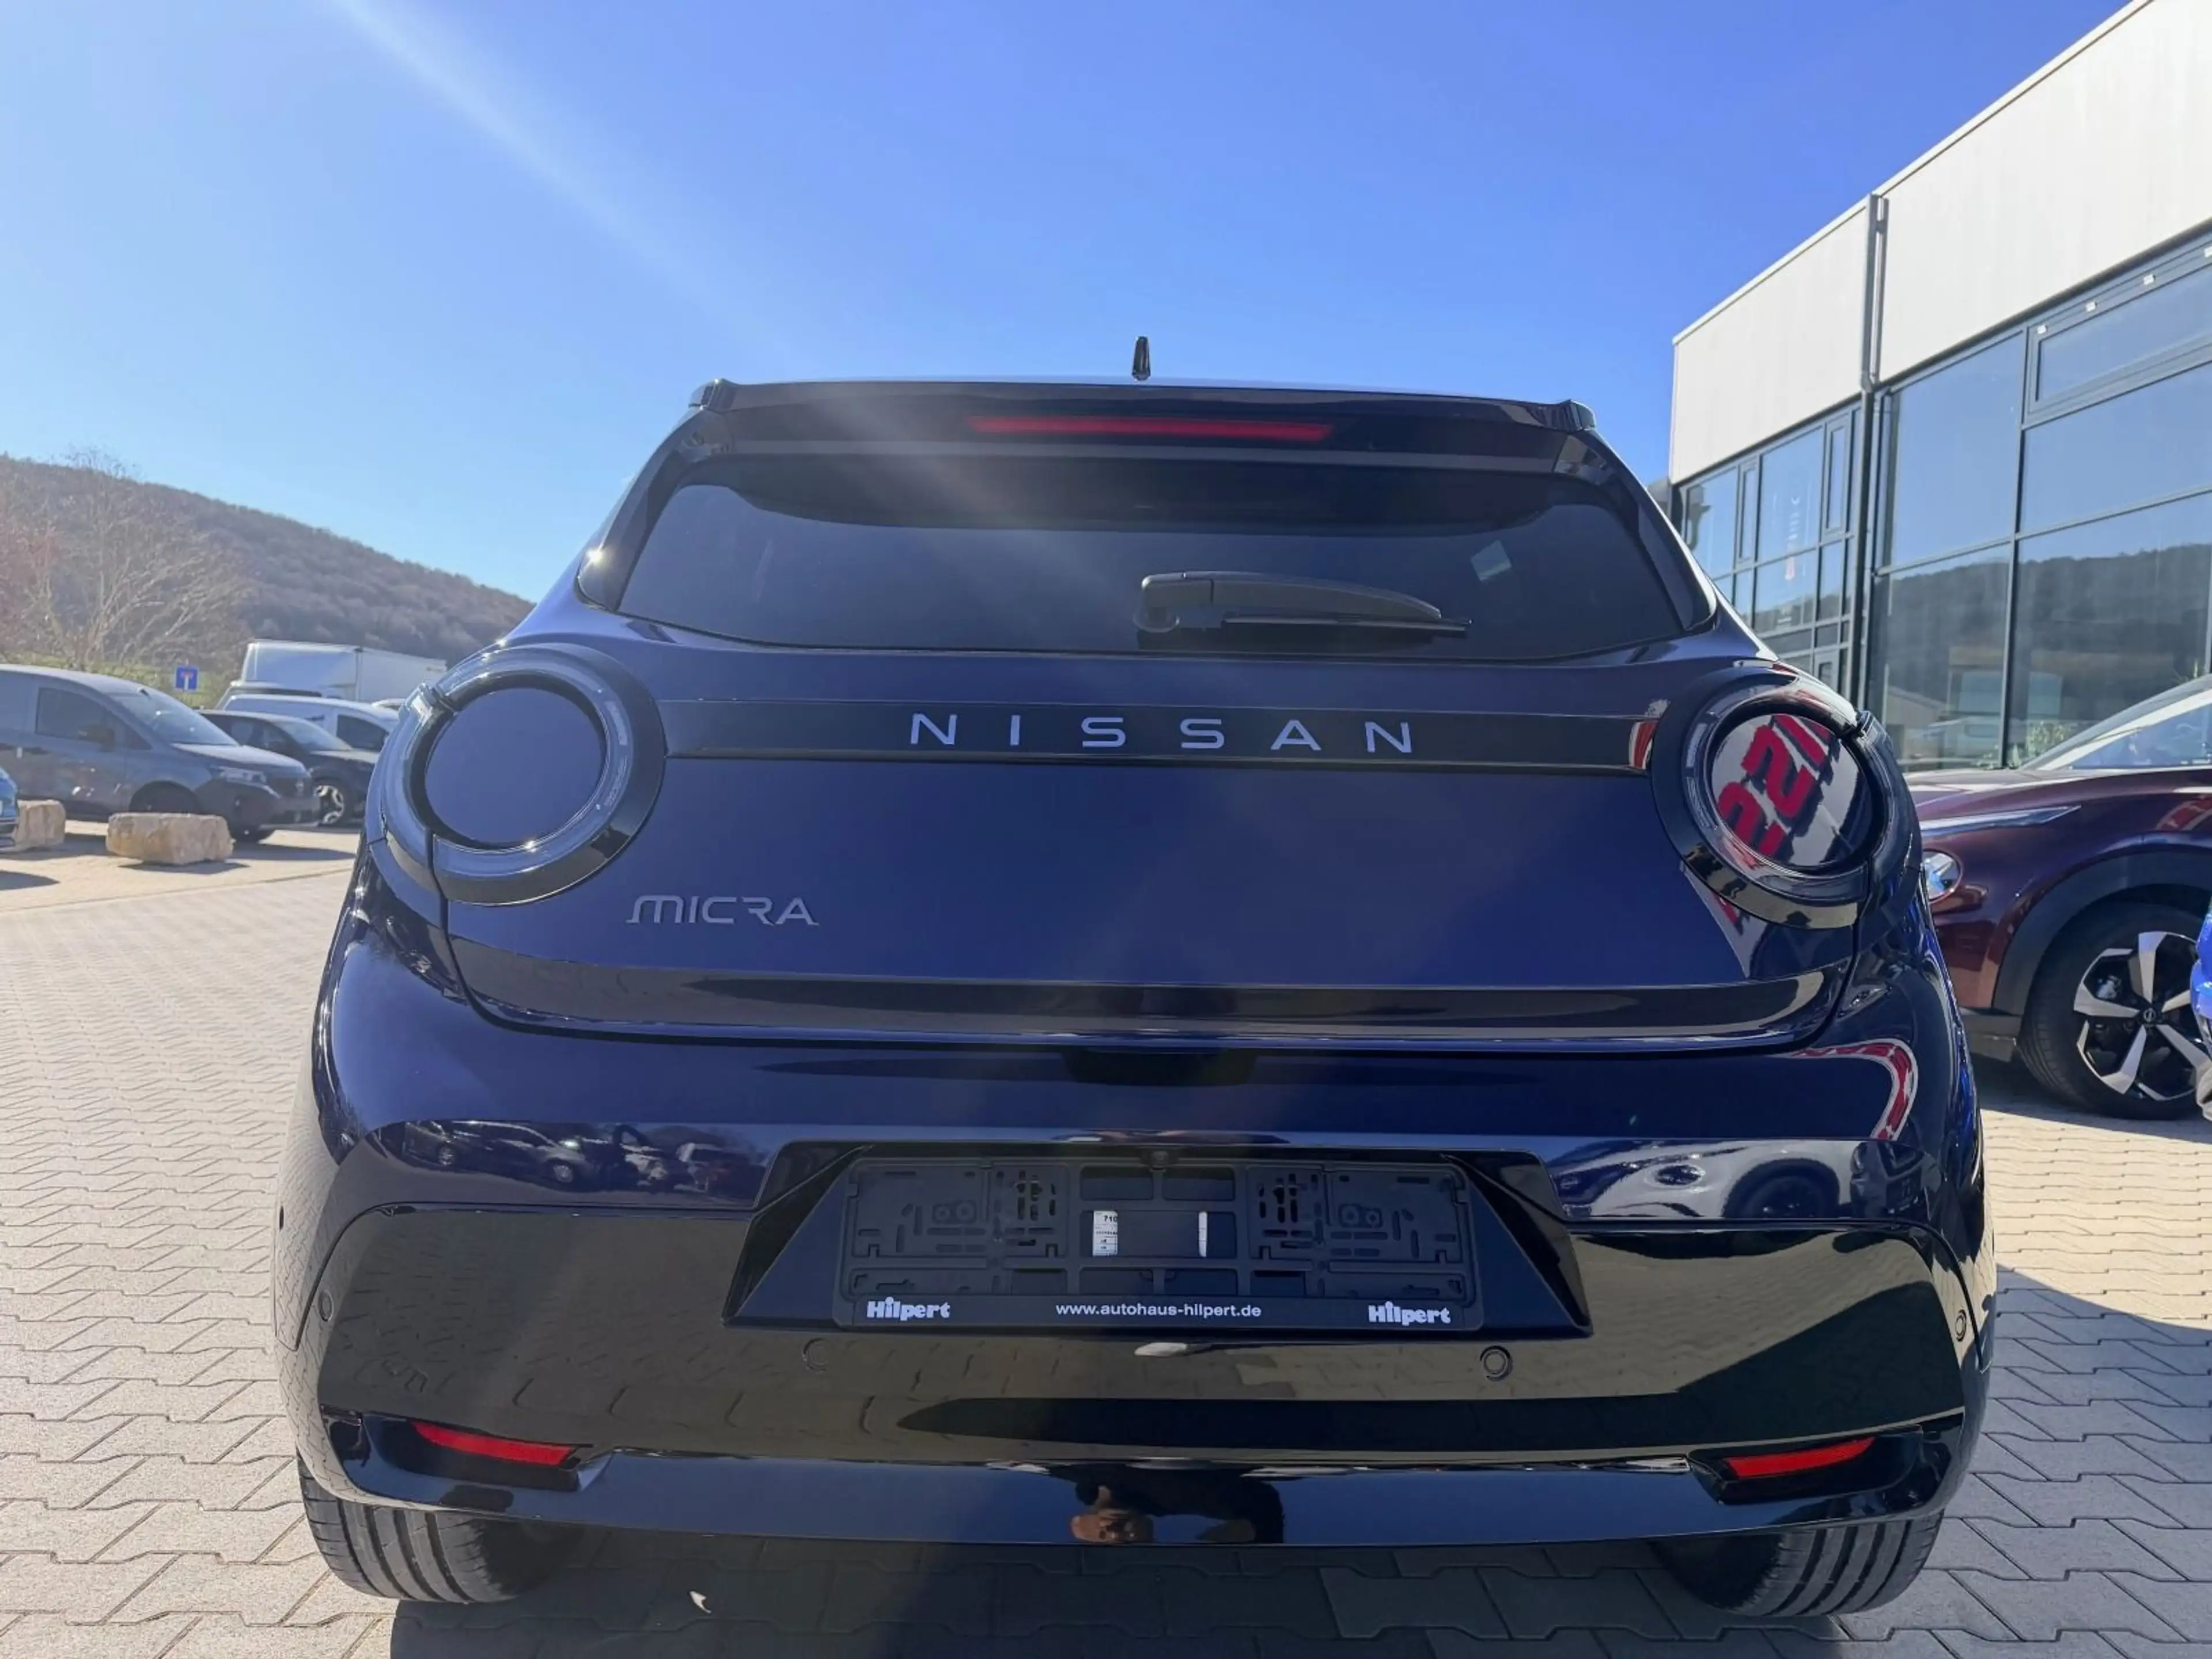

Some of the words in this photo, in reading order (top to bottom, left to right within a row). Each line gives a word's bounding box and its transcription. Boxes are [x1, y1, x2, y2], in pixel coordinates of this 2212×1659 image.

[910, 713, 1412, 753] NISSAN
[625, 895, 819, 926] MICRA
[866, 1297, 950, 1321] Hilpert
[1055, 1302, 1262, 1319] www.autohaus-hilpert.de
[1368, 1301, 1451, 1325] Hilpert
